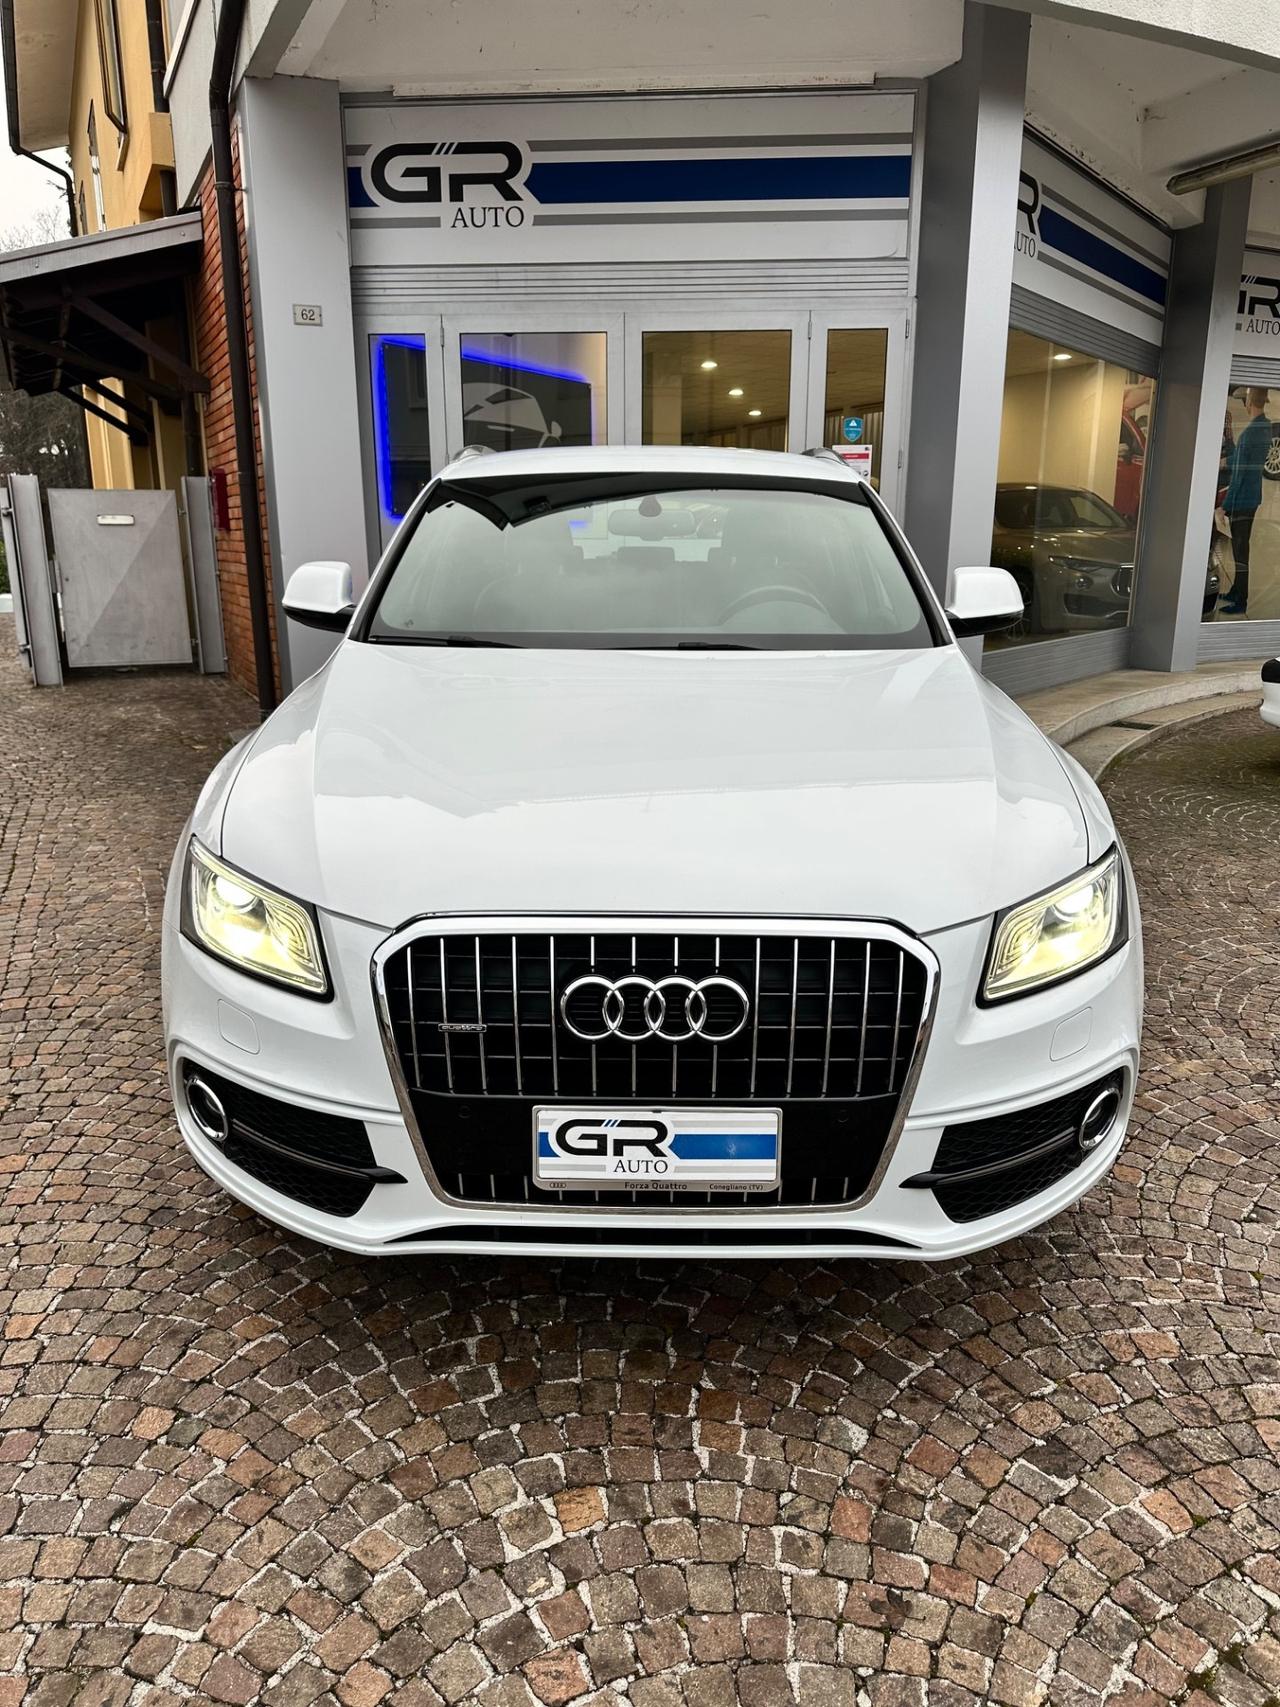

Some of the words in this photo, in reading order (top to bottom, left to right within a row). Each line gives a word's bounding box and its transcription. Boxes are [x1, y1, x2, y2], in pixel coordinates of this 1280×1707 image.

[371, 141, 524, 203] GR
[450, 205, 525, 228] AUTO
[1014, 230, 1036, 258] UTO
[301, 308, 315, 321] 62
[1246, 318, 1280, 336] AUTO
[555, 1118, 669, 1157] GR
[613, 1159, 669, 1174] AUTO
[624, 1181, 649, 1190] Forza
[651, 1182, 688, 1191] Quattro
[709, 1183, 748, 1192] Conegliano
[748, 1184, 764, 1192] (TV)
